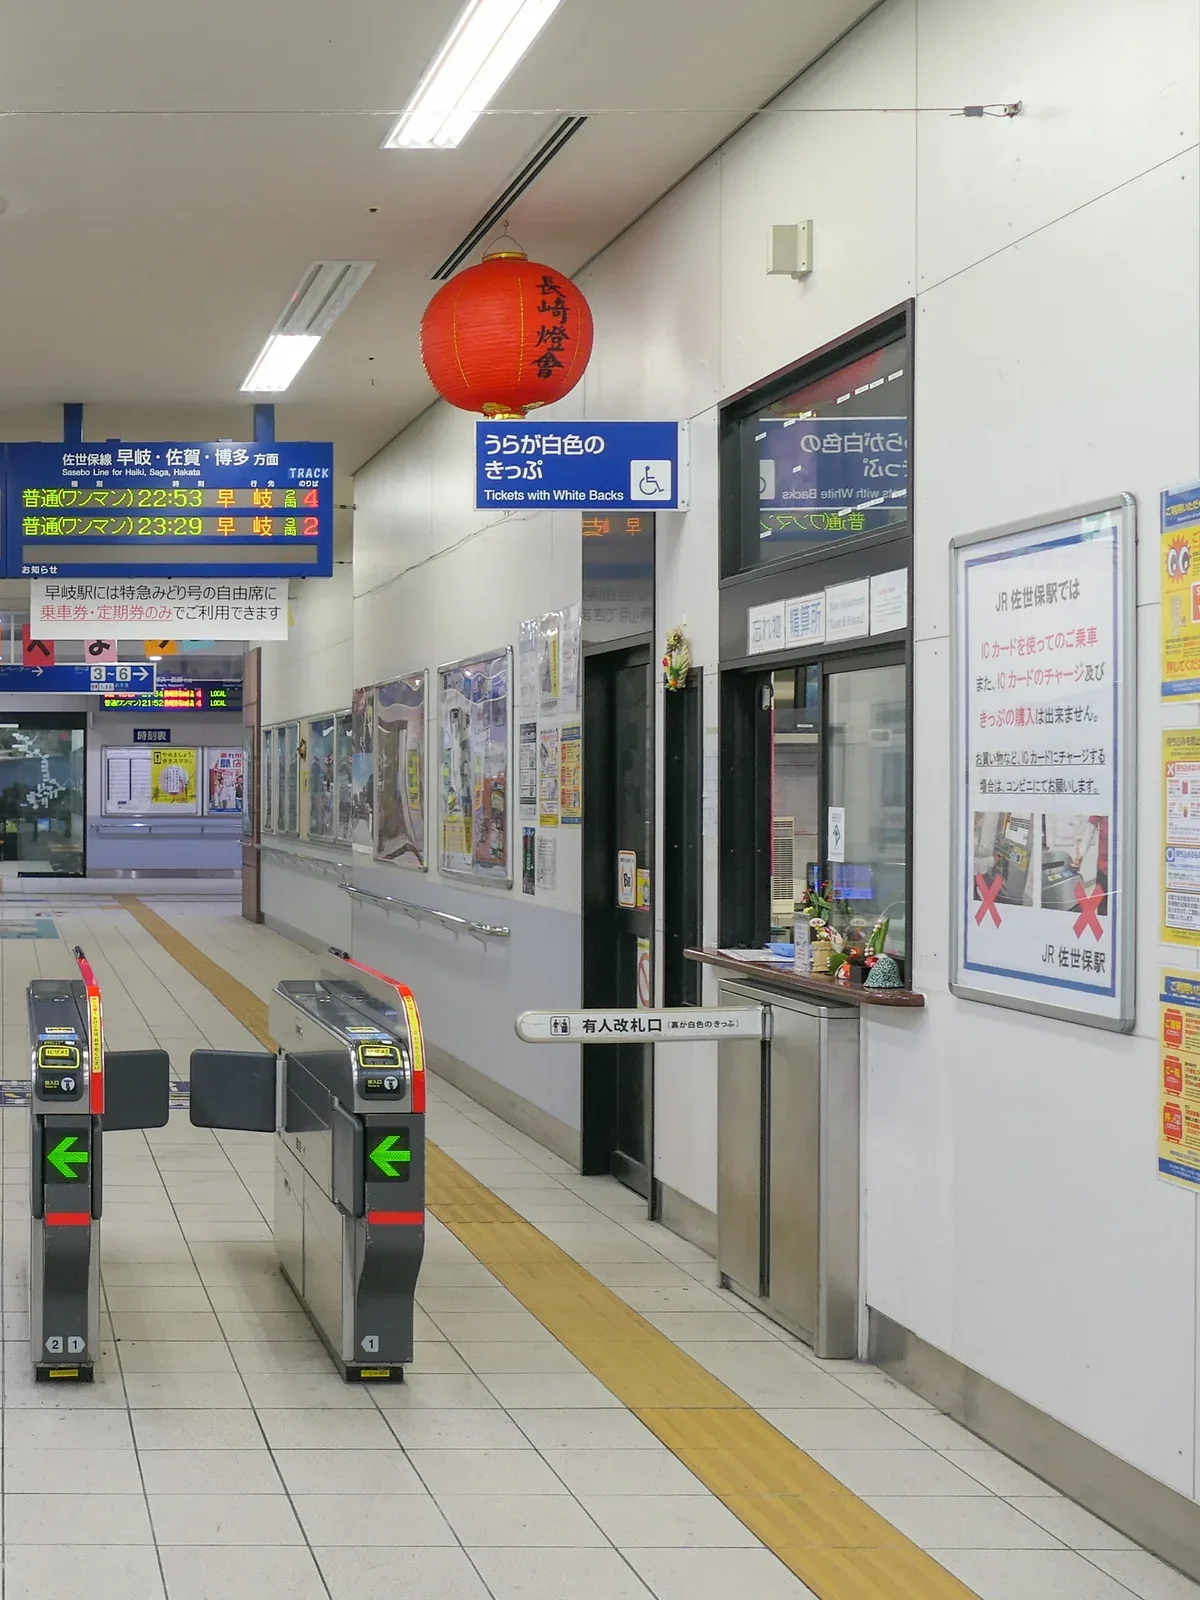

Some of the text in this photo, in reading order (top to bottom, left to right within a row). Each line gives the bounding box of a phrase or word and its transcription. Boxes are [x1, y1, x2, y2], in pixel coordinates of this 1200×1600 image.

[531, 275, 570, 378] 長崎燈會
[484, 434, 605, 455] うらが白色の
[62, 448, 279, 467] 佐世保線 早岐・佐賀・博多 方面
[62, 468, 201, 479] Sasebo Line for Haiki, Saga, Hakata
[289, 467, 329, 479] TRACK
[484, 459, 543, 480] きっぷ
[137, 489, 203, 508] 22:53
[303, 489, 319, 507] 4
[484, 489, 624, 501] Tickets with White Backs
[137, 517, 203, 536] 23:29
[303, 517, 319, 536] 2
[21, 565, 58, 574] お知らせ
[45, 585, 277, 601] 早岐駅には特急みどり号の自由席に
[40, 605, 282, 621] 乗車券・定期券のみでご利用できます
[137, 731, 167, 741] 時刻表
[582, 1018, 662, 1034] 有人改札口
[51, 1339, 59, 1350] 2
